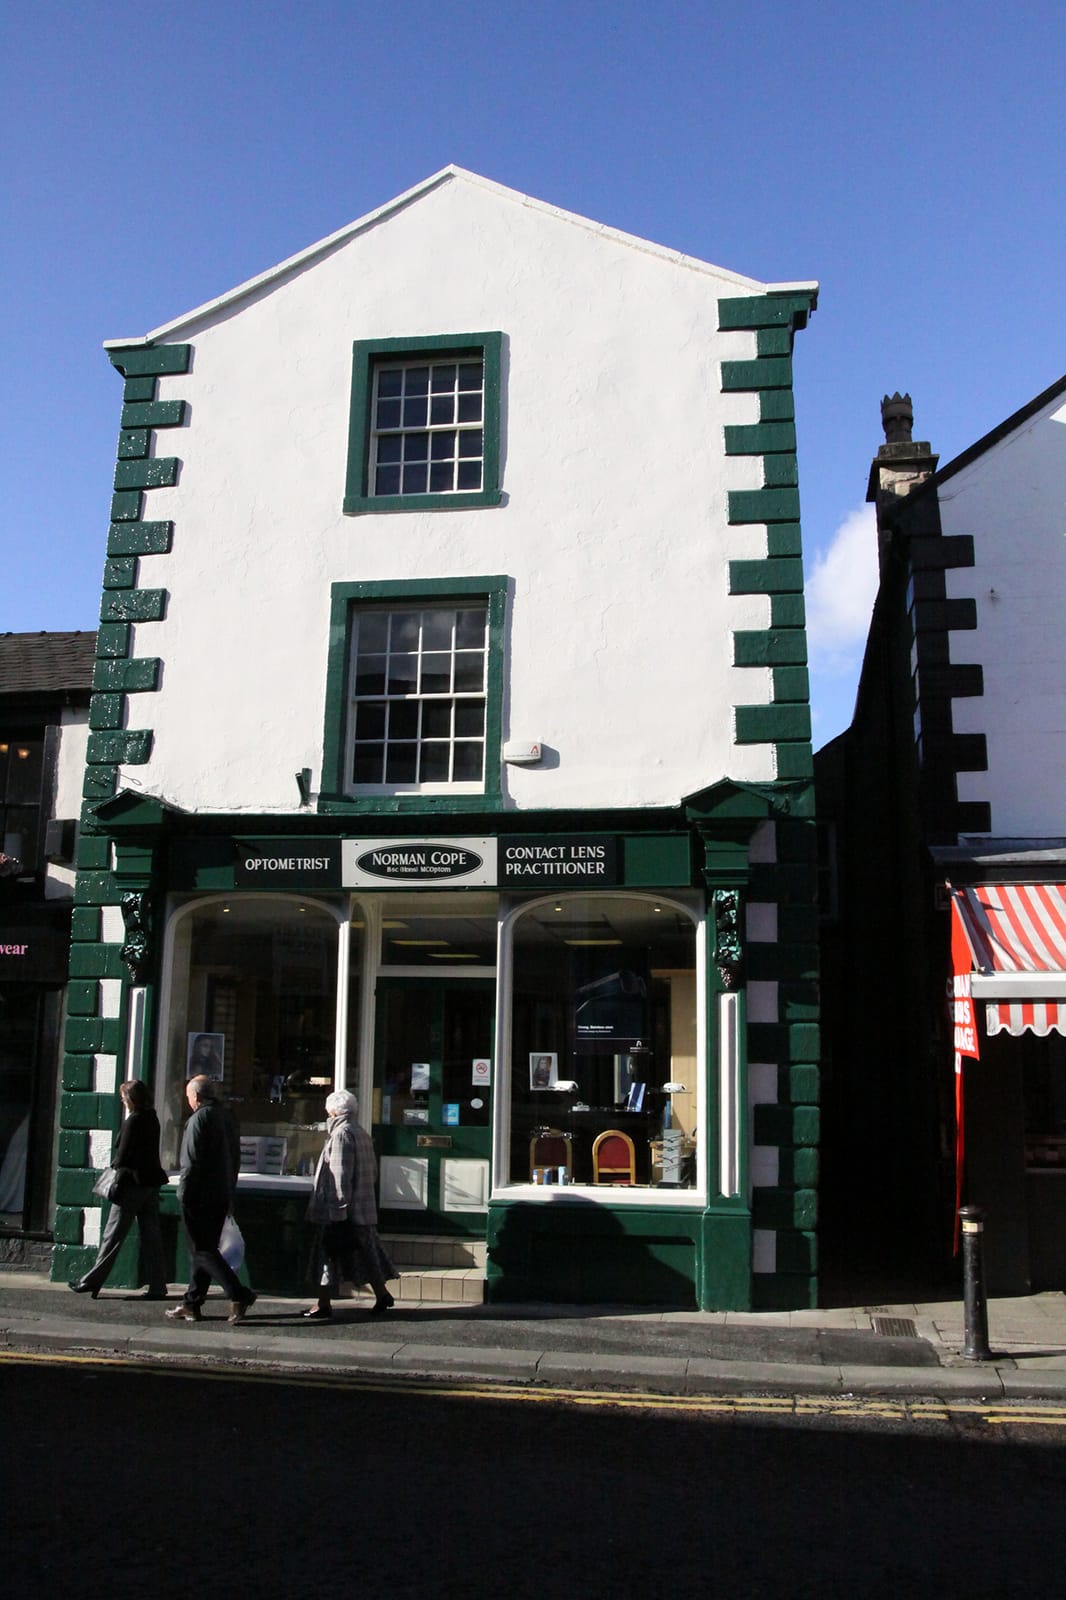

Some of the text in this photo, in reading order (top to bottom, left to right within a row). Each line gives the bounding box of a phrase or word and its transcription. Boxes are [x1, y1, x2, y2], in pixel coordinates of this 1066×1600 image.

[372, 851, 467, 866] NORMAN COPE
[505, 845, 606, 859] CONTACT LENS
[244, 857, 331, 871] OPTOMETRIST
[505, 861, 605, 875] PRACTITIONER
